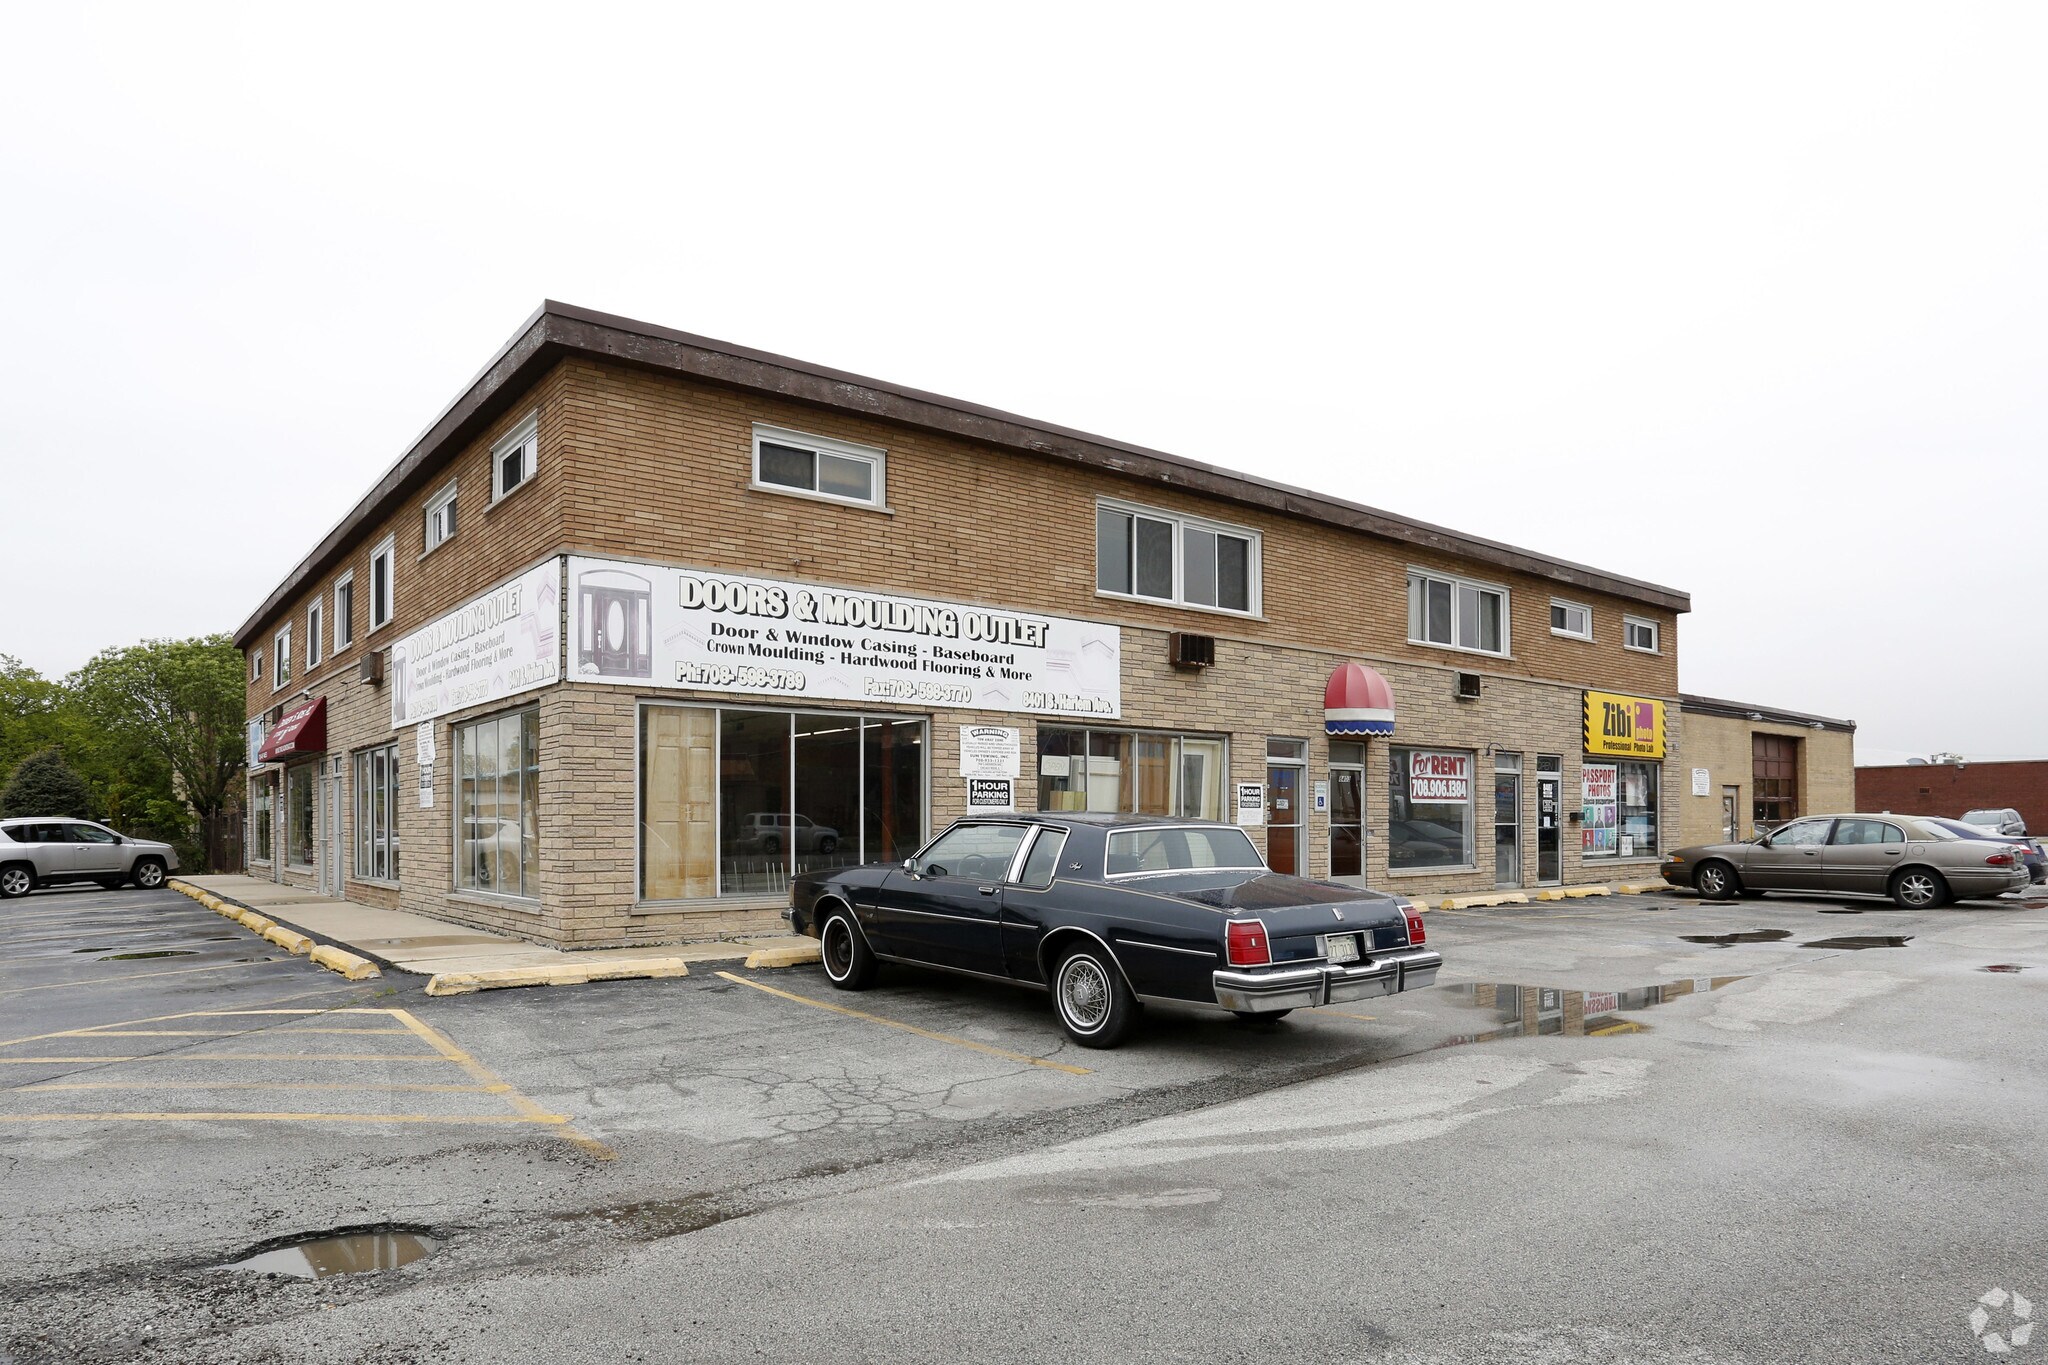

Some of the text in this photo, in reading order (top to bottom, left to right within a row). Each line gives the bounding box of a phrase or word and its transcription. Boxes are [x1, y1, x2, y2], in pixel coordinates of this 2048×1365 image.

[487, 583, 522, 629] OUTLET
[679, 576, 1049, 648] DOORS & MOULDING OUTLET
[451, 646, 470, 663] Casing
[474, 631, 505, 654] Baseboard
[711, 622, 759, 639] Door
[766, 628, 779, 641] &
[786, 630, 855, 648] Window
[861, 637, 917, 658] Casing
[933, 646, 1014, 665] Baseboard
[470, 652, 493, 672] Flooring
[707, 639, 745, 655] Crown
[748, 643, 825, 665] Moulding
[841, 652, 917, 670] Hardwood
[922, 660, 981, 679] Flooring
[986, 666, 995, 678] &
[1000, 668, 1033, 681] More
[1022, 691, 1113, 713] 8401 S. Harlem Ave.
[1603, 701, 1632, 738] Zibi
[971, 729, 1008, 738] WARNING
[1635, 725, 1653, 740] photo
[1603, 740, 1632, 751] Professional
[1634, 742, 1646, 752] Photo
[1412, 752, 1466, 776] For RENT
[1582, 768, 1616, 783] PASSPORT
[972, 780, 1008, 791] 1 HOUR
[972, 791, 1008, 799] PARKING
[1241, 787, 1244, 796] 1
[1412, 779, 1467, 798] 708.906.1384
[1588, 785, 1612, 797] PHOTOS
